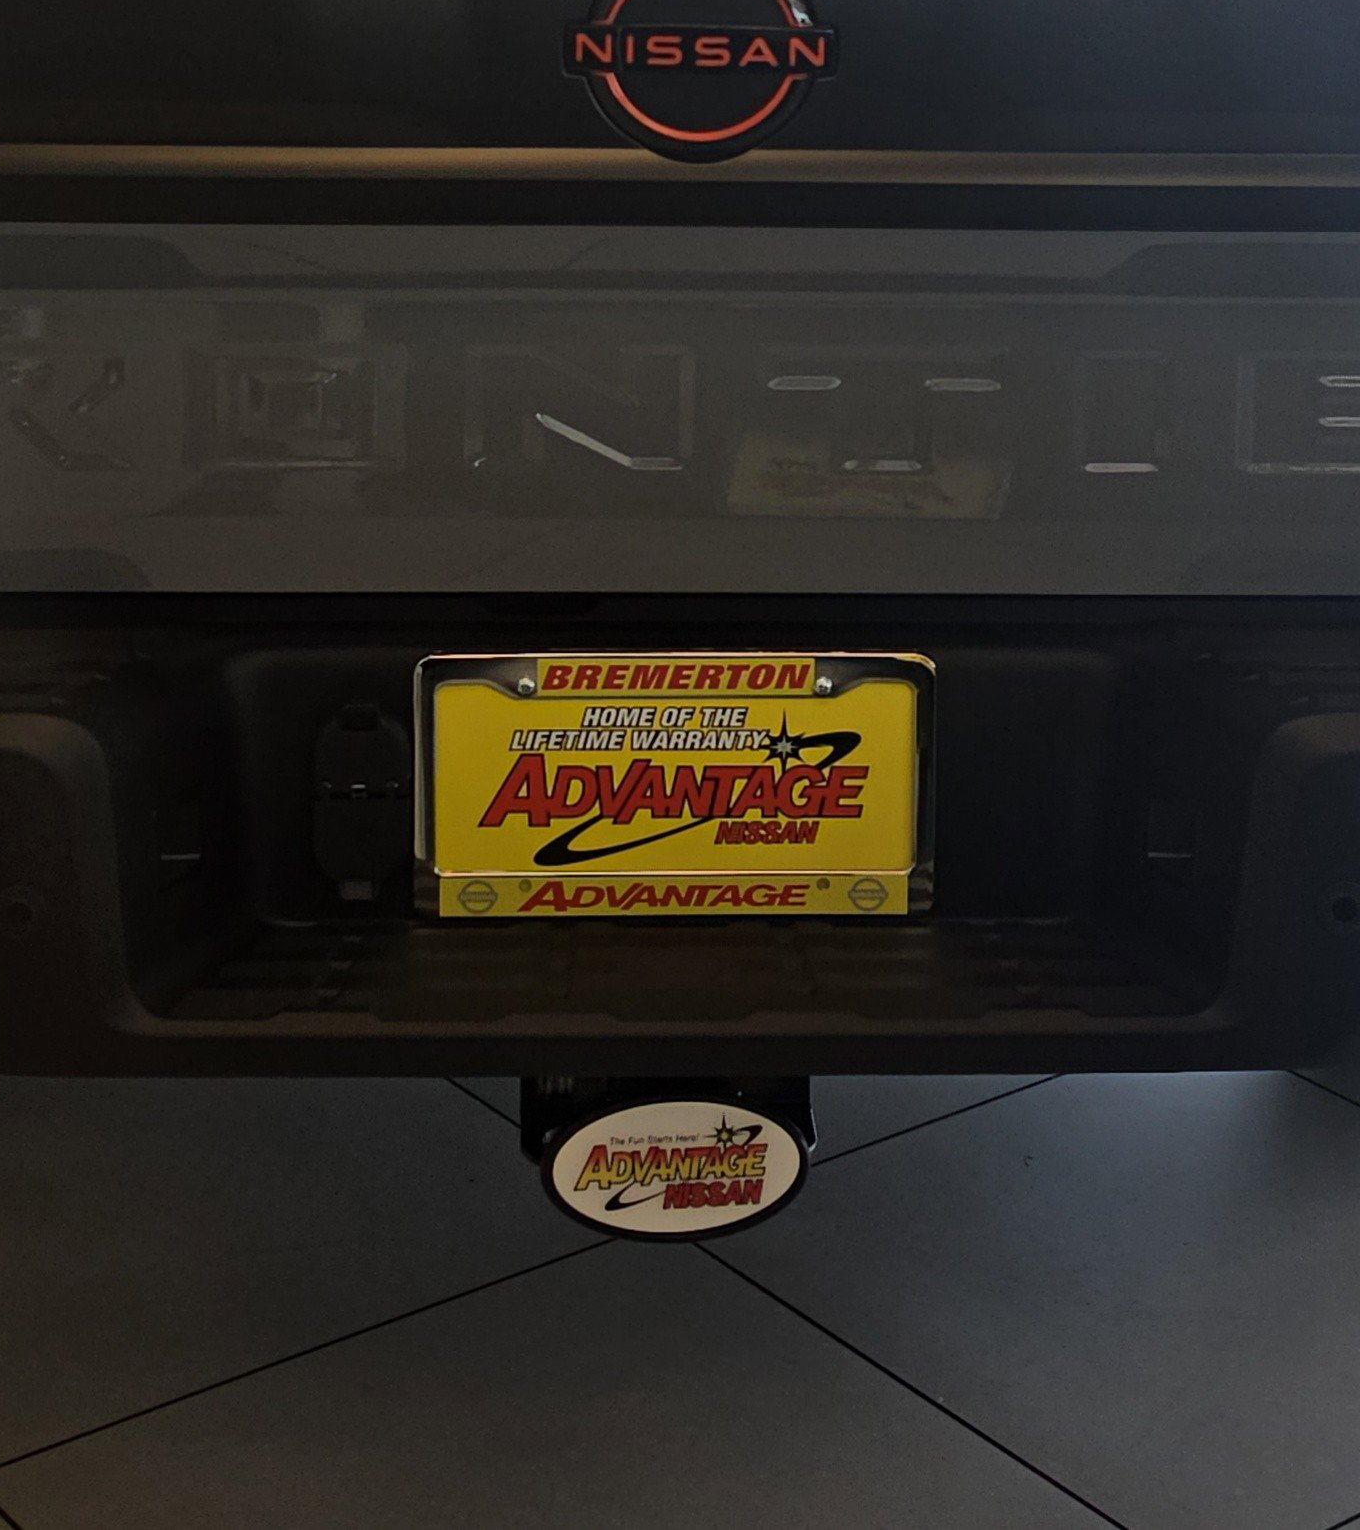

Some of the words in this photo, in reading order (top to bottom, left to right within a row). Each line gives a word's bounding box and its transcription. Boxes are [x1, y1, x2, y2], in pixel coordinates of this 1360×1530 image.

[575, 33, 825, 67] NISSAN
[542, 663, 811, 691] BREMERTON
[581, 706, 654, 727] HOME
[661, 706, 694, 727] OF
[700, 706, 747, 727] THE
[508, 729, 624, 751] LIFETIME
[631, 729, 770, 751] WARRANTY
[477, 753, 869, 828] ADVANTAGE
[714, 820, 819, 845] NISSAN
[517, 880, 810, 912] ADVANTAGE
[574, 1143, 768, 1191] ADVANTAGE
[663, 1179, 763, 1210] NISSAN
